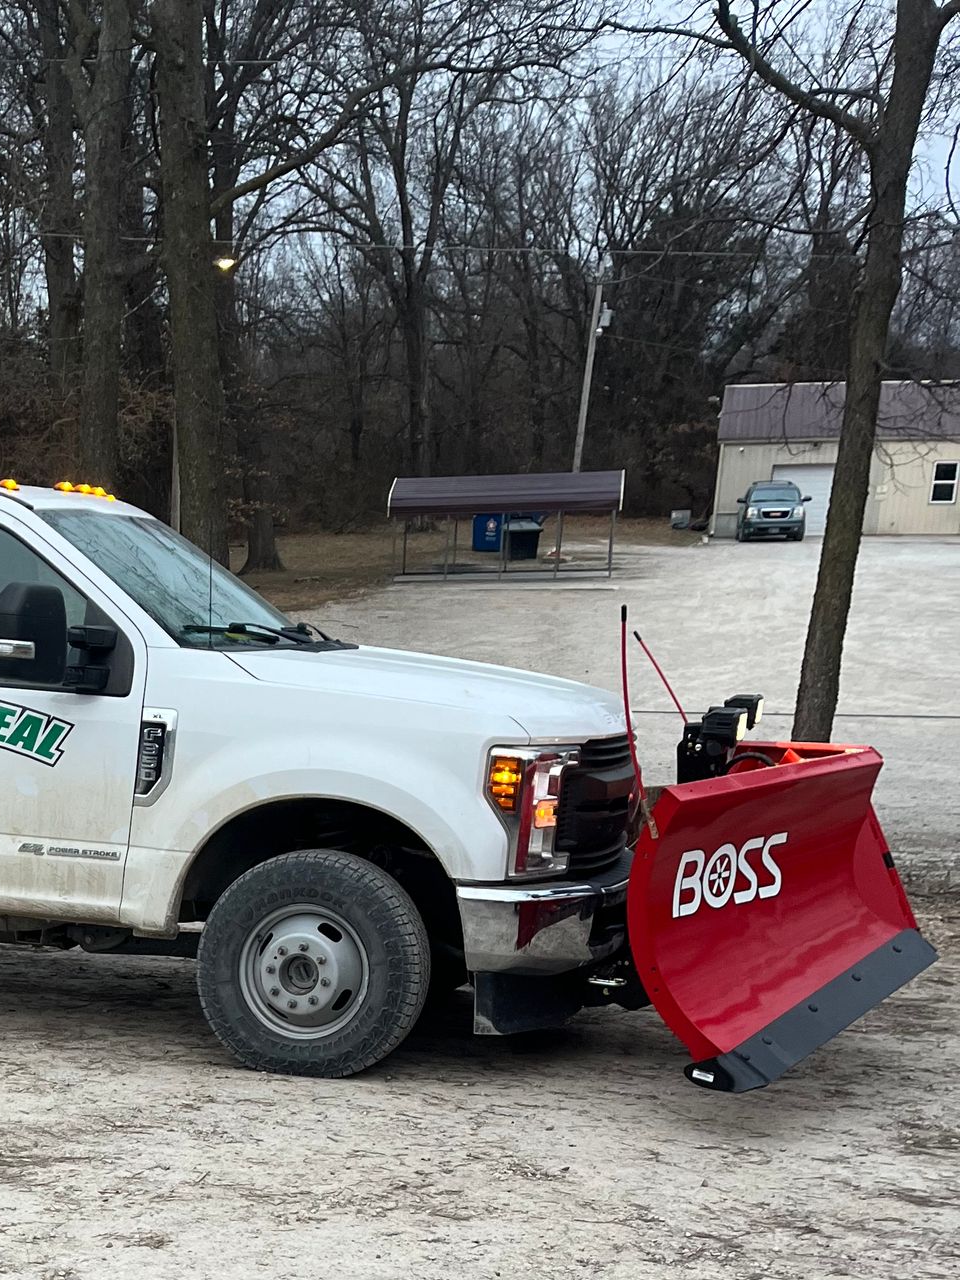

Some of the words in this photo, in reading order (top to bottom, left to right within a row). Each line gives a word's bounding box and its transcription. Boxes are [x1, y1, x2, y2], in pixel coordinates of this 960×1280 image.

[48, 846, 80, 855] POWER
[81, 849, 118, 858] STROKE
[672, 831, 788, 918] BOSS
